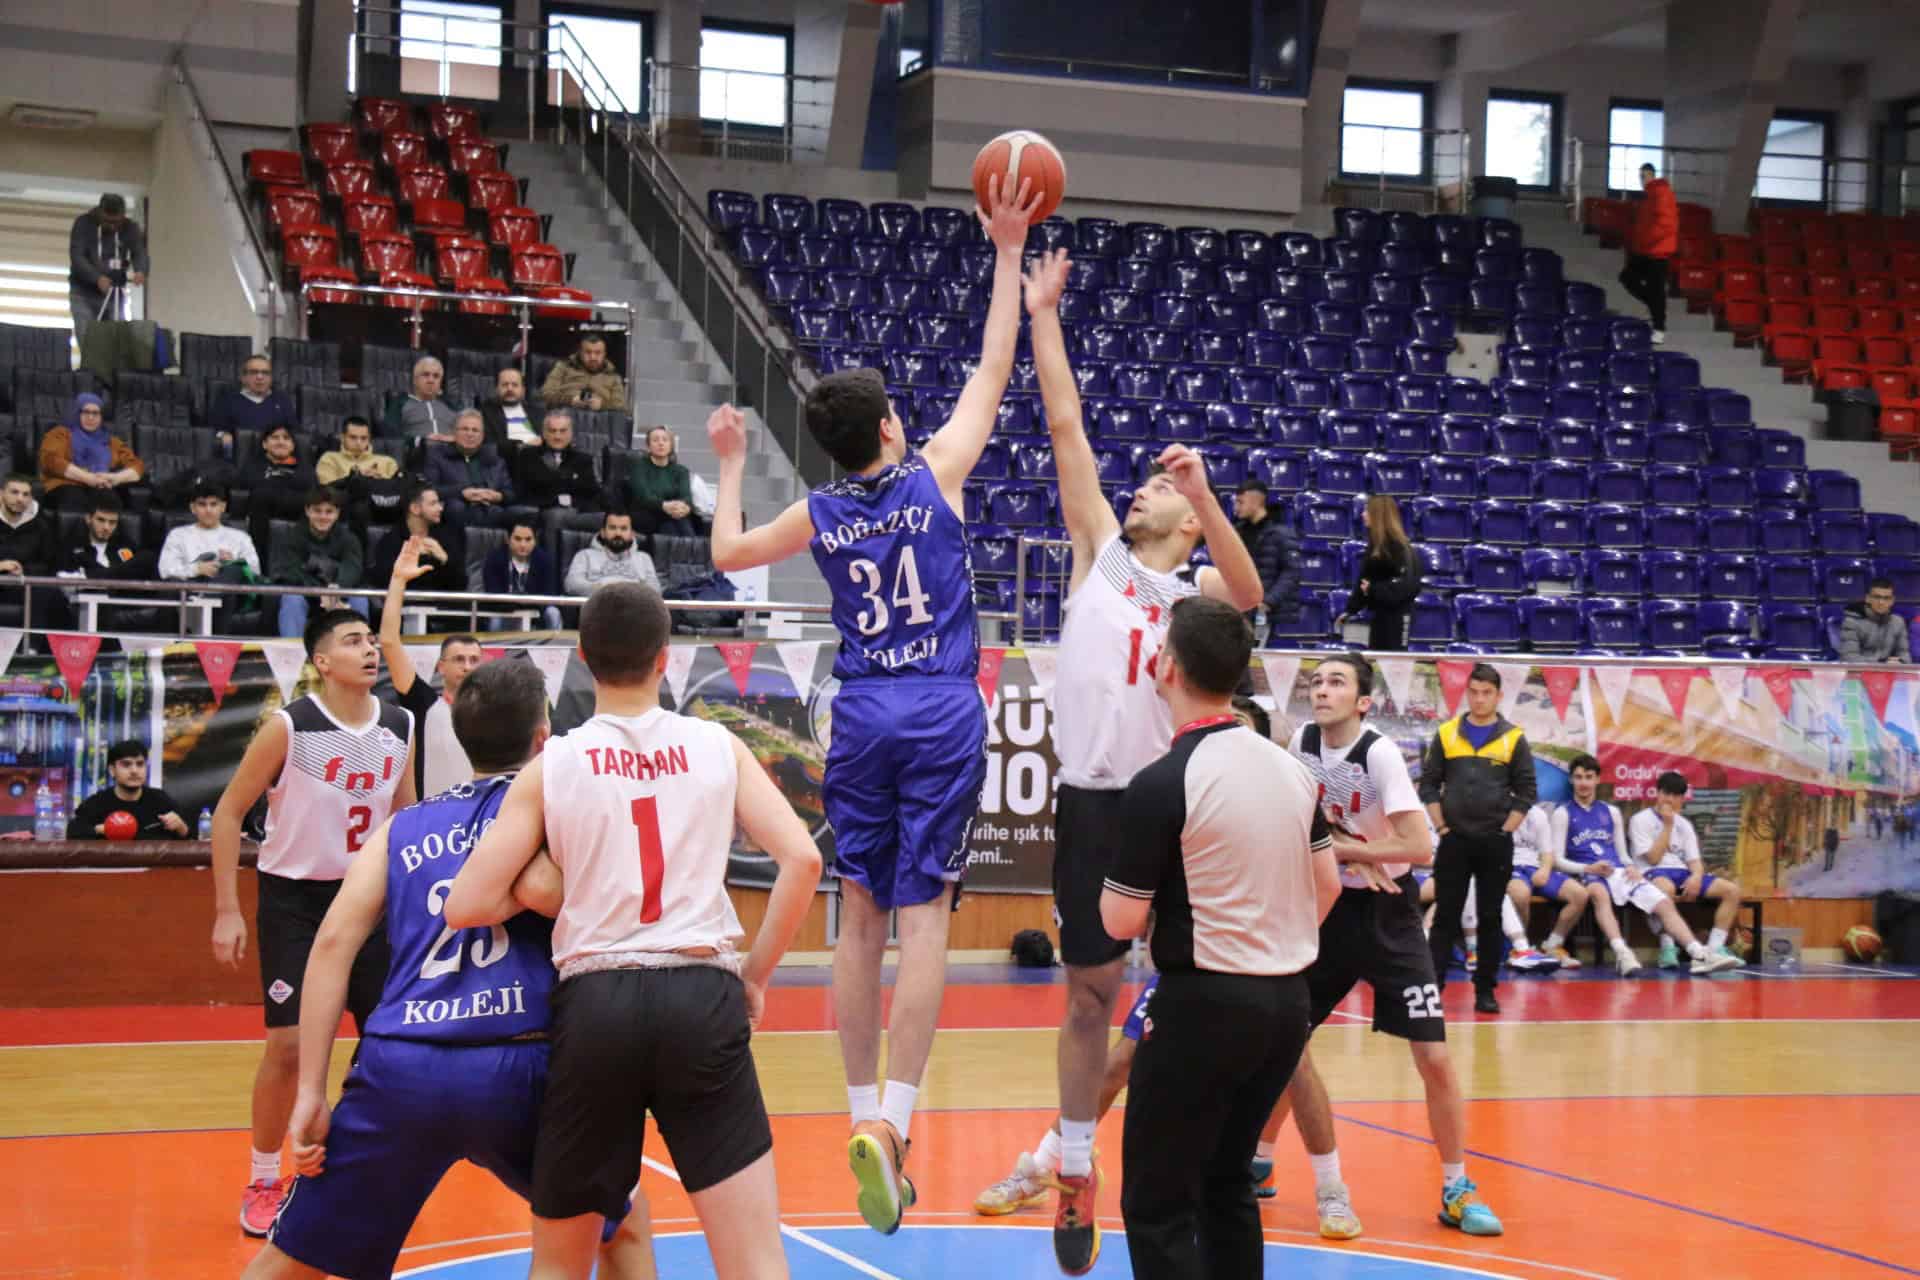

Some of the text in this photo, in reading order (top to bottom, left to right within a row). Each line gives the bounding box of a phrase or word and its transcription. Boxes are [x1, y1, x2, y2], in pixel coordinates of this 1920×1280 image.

[849, 545, 933, 636] 34
[323, 756, 393, 791] fnl
[585, 745, 689, 781] TARHAN
[347, 805, 372, 853] 2
[631, 793, 664, 924] 1
[402, 980, 526, 1025] KOLEJİ
[1403, 983, 1446, 1019] 22
